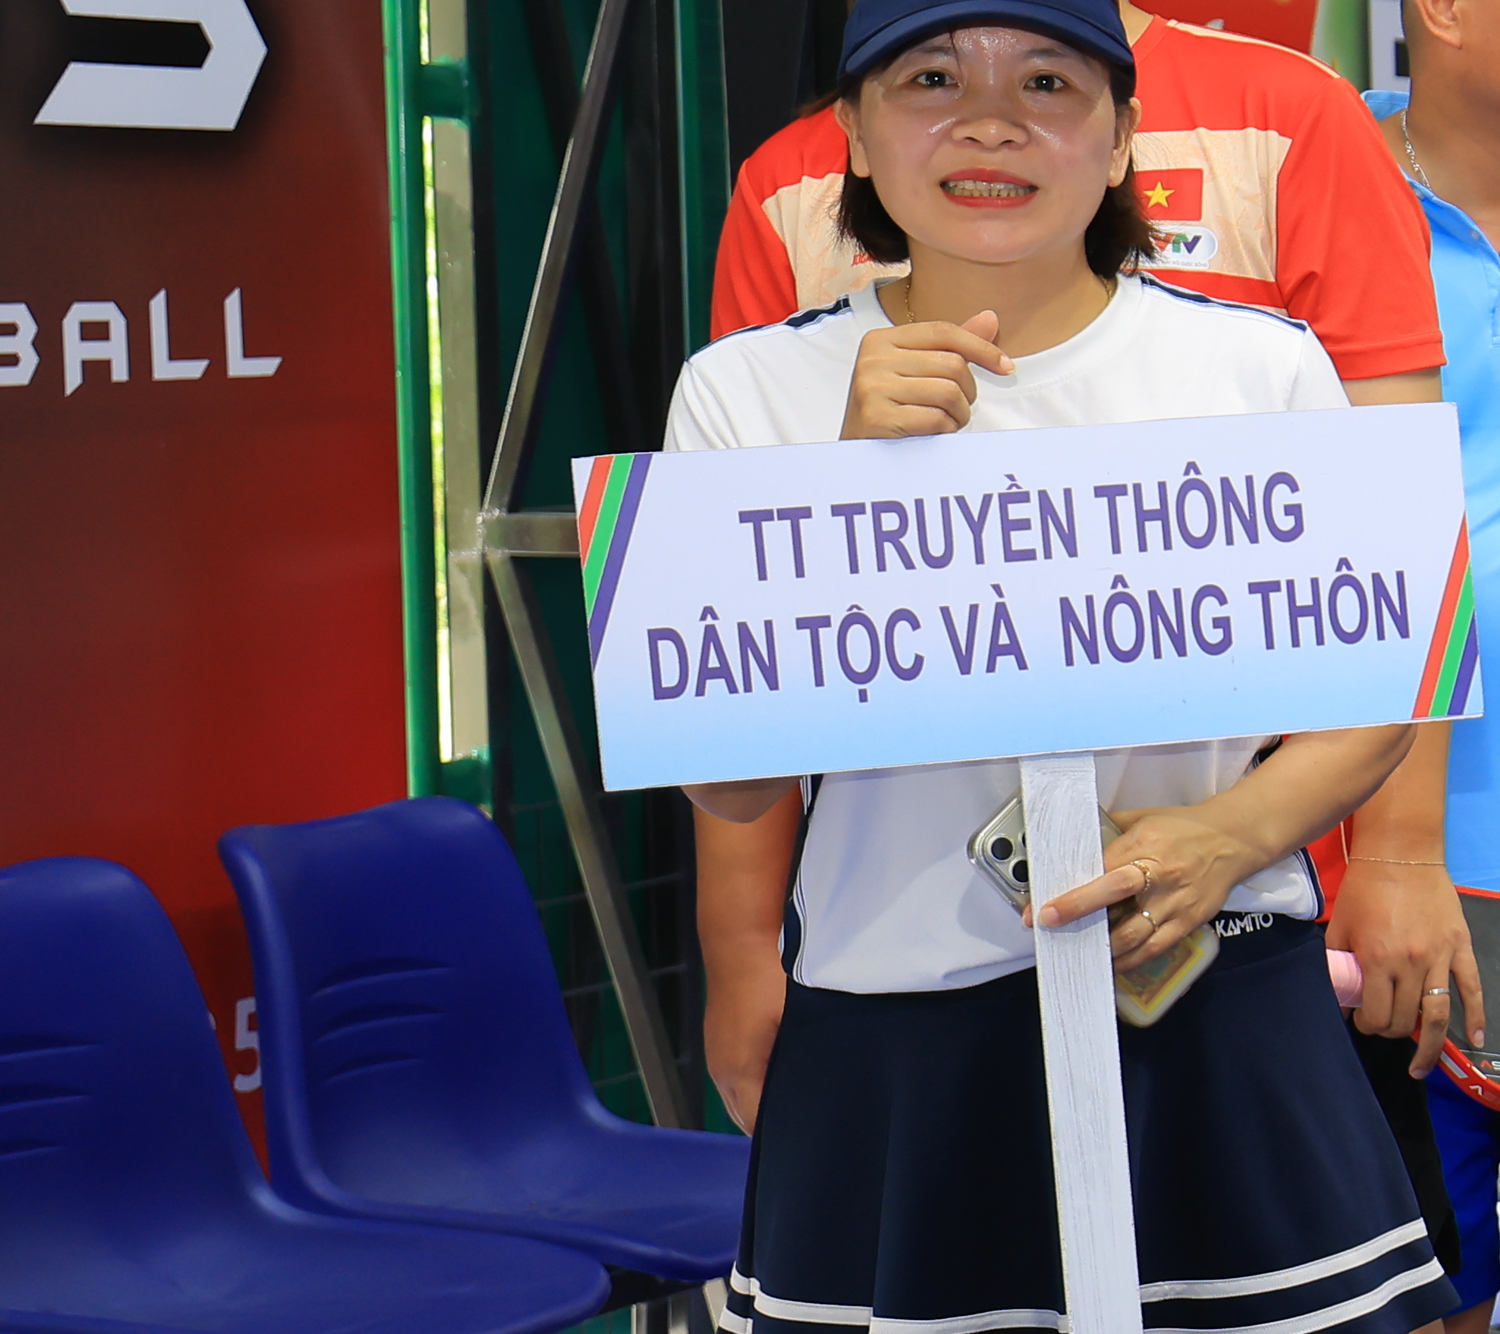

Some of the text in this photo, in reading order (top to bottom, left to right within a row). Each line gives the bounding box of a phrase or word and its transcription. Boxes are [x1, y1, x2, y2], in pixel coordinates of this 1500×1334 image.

[1152, 232, 1203, 255] VTV
[0, 288, 282, 396] BALL
[739, 461, 1304, 581] TT TRUYỀN THÔNG
[647, 558, 1411, 703] DÂN TỘC VÀ NÔNG THÔN
[1215, 913, 1274, 938] KAMITO
